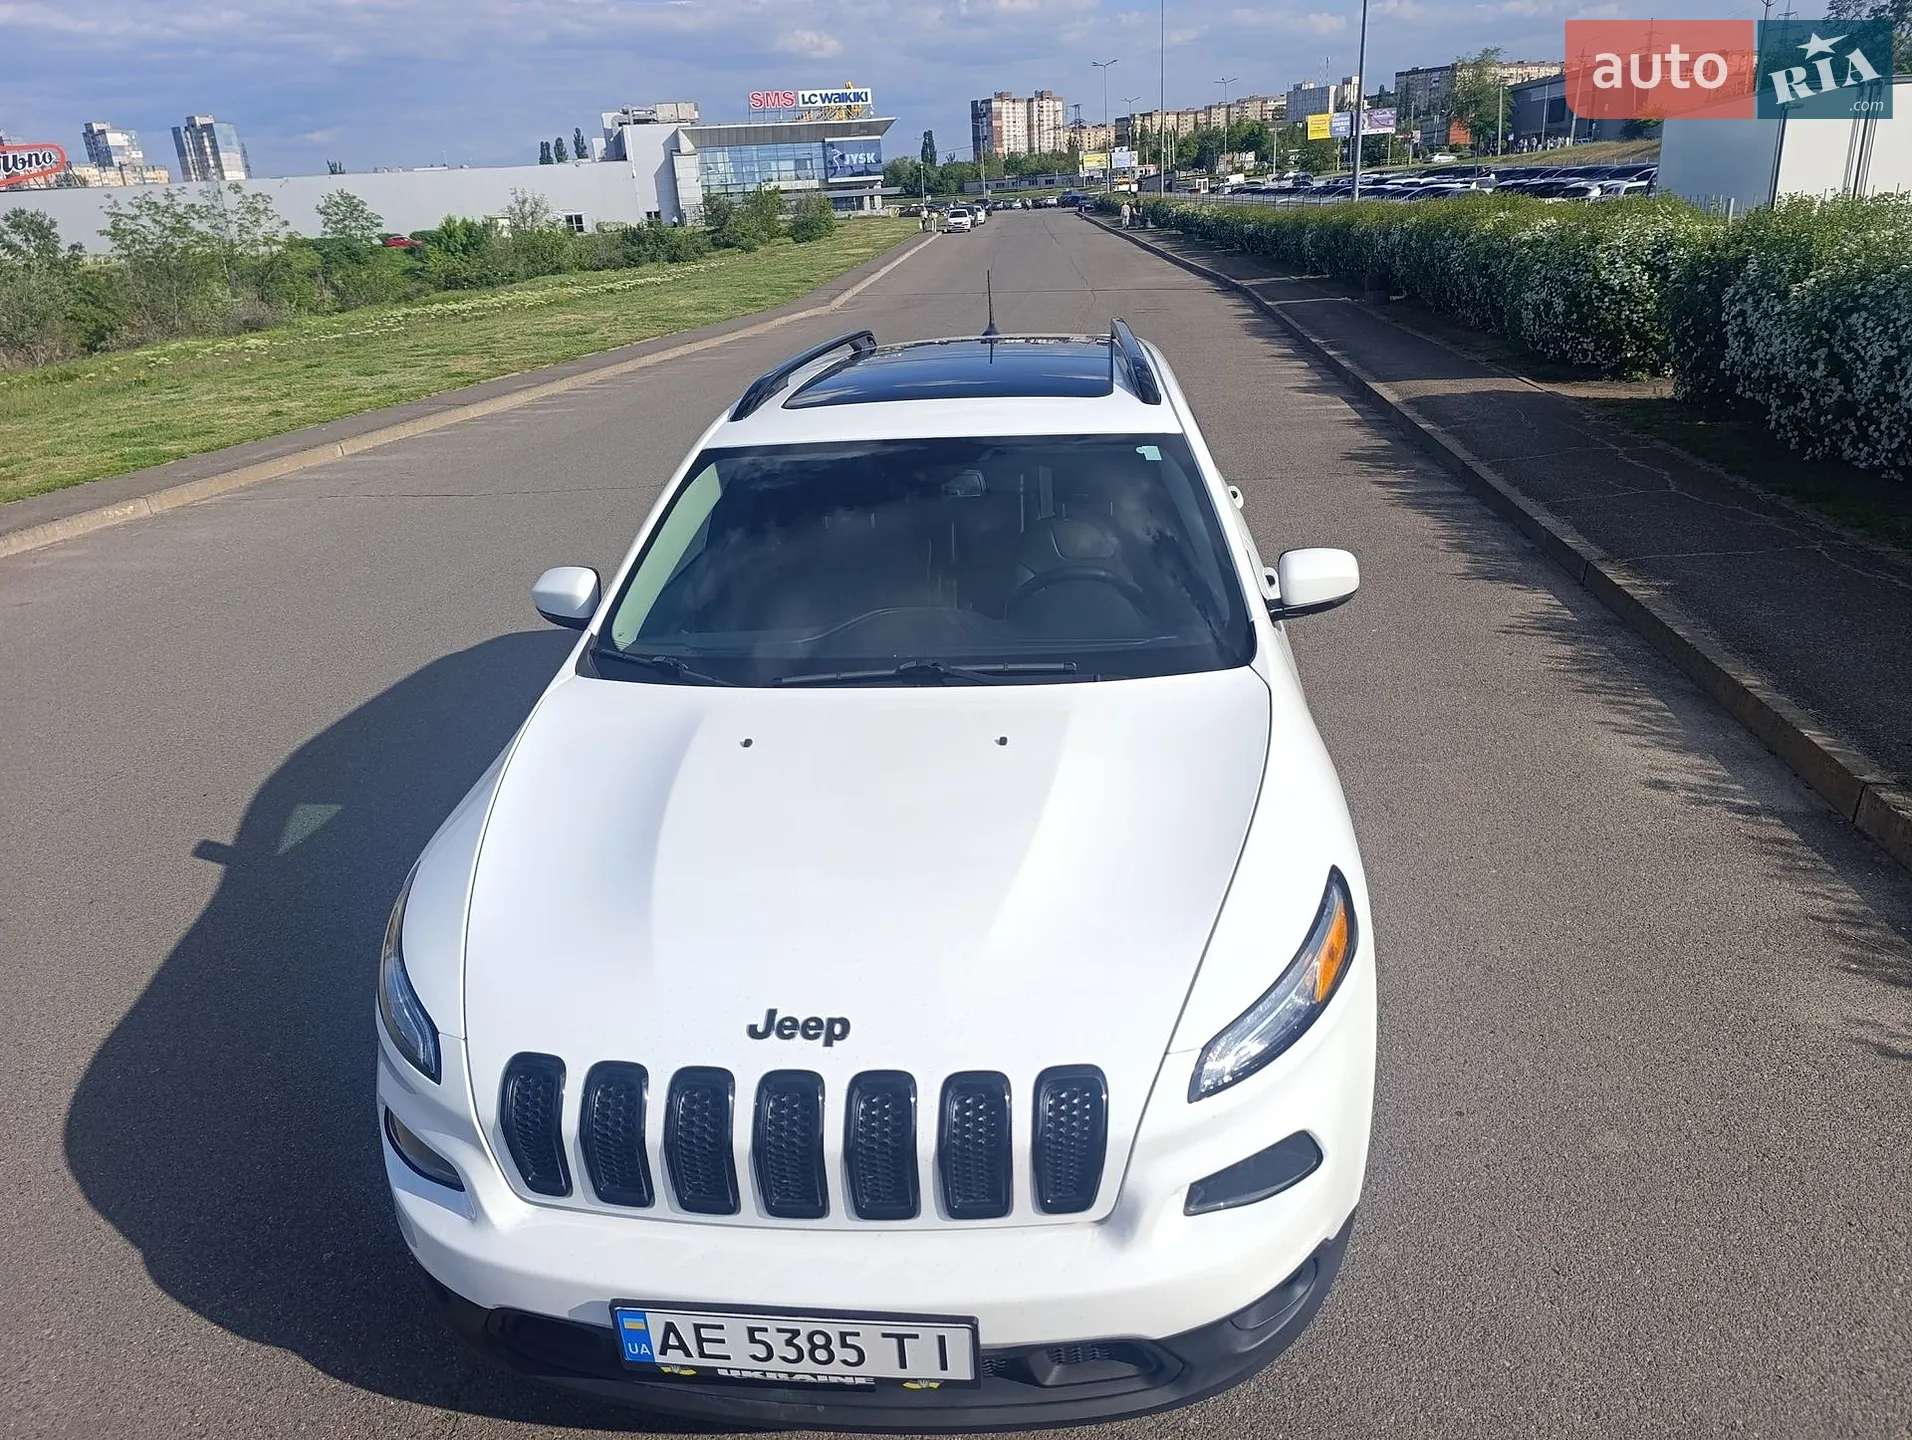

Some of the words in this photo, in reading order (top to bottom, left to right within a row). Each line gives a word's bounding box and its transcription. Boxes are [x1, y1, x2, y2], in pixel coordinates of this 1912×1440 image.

[749, 90, 795, 109] SMS
[801, 94, 819, 105] LC
[844, 152, 877, 165] JYSK
[746, 1007, 851, 1048] Jeep
[628, 1342, 651, 1356] UA
[658, 1320, 732, 1361] AE
[746, 1325, 866, 1368] 5385
